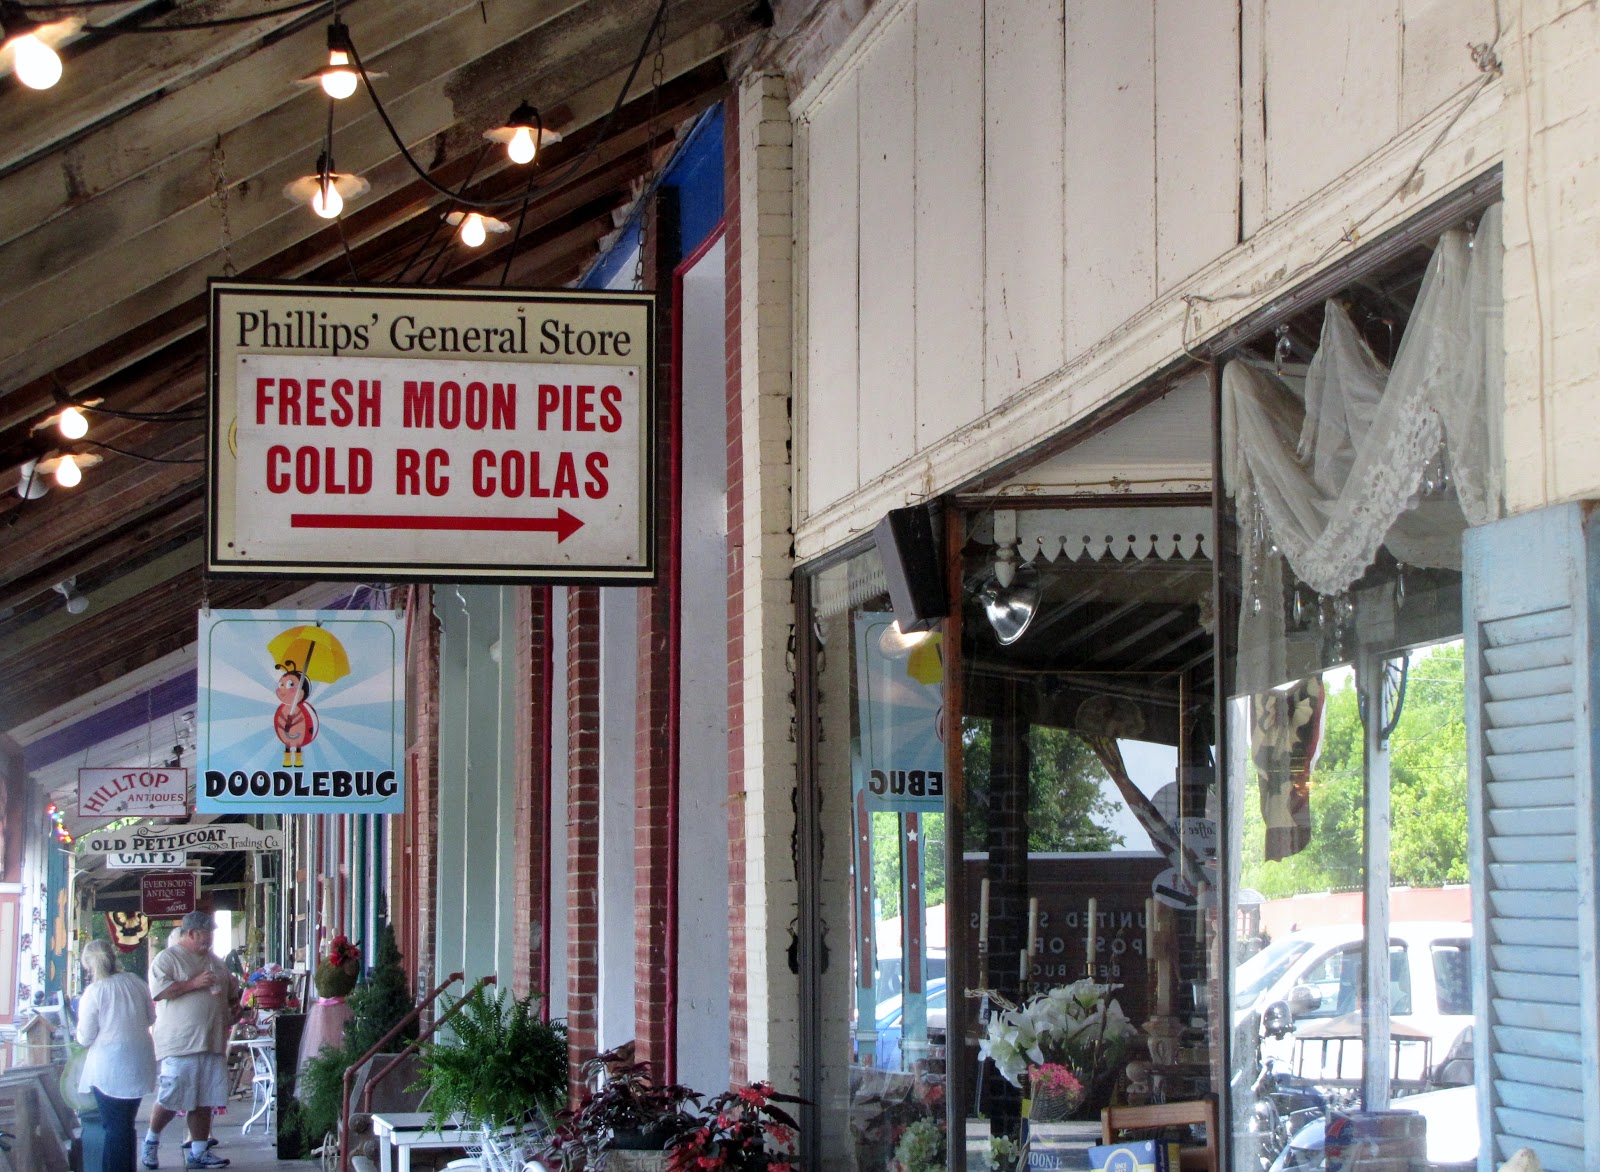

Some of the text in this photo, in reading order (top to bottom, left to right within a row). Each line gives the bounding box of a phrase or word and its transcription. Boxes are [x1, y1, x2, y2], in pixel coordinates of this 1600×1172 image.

[390, 314, 529, 355] General
[539, 319, 631, 357] Store
[255, 377, 623, 433] FRESH MOON PIES
[266, 444, 609, 500] COLD RC COLAS
[83, 771, 169, 813] HILLTOP
[128, 793, 185, 802] ANTIQUES
[205, 770, 398, 797] DOODLEBUG
[91, 839, 127, 851] OLD
[132, 829, 226, 851] PETTICOAT
[228, 836, 263, 850] Trading
[146, 888, 186, 898] ANTIQUES
